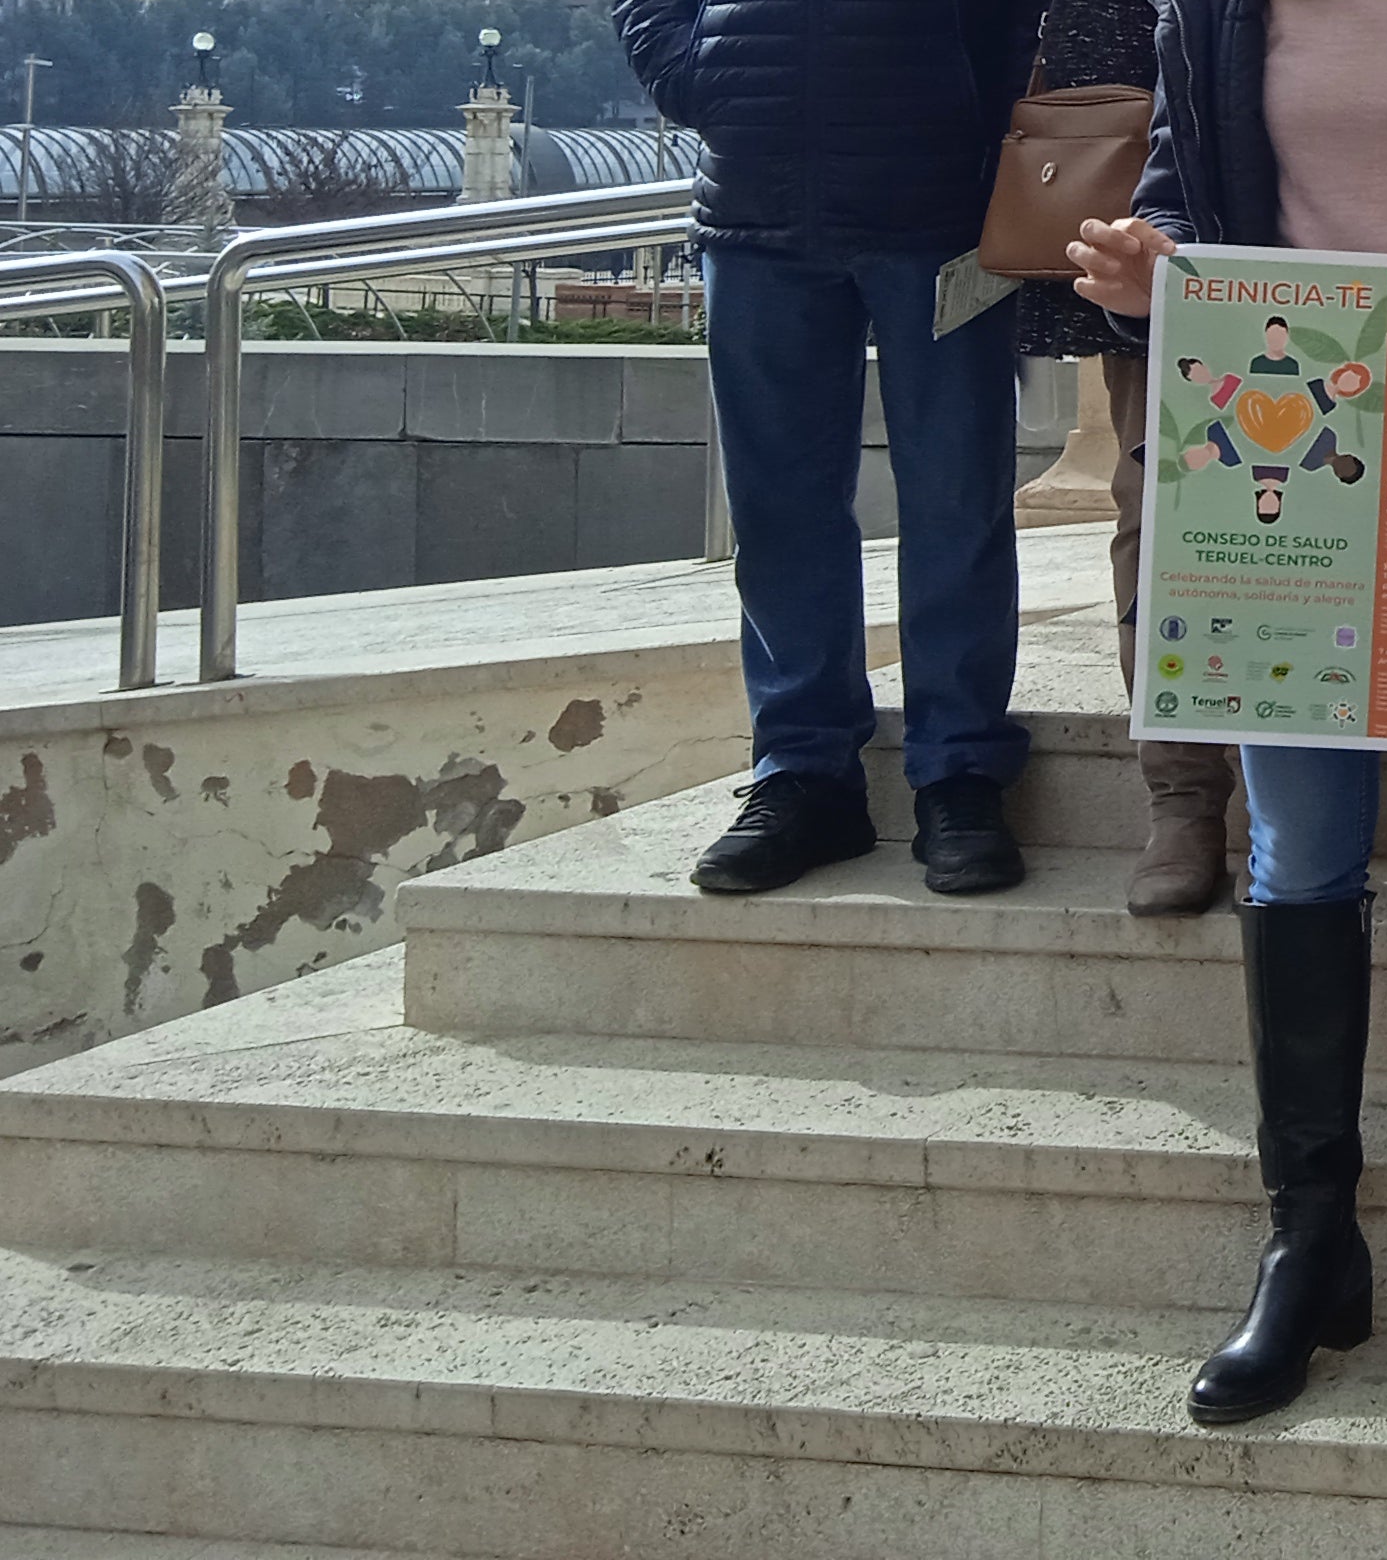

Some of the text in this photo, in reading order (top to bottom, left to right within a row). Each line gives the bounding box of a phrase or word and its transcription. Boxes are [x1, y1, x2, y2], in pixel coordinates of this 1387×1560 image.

[1183, 276, 1373, 310] REINICIA-TE
[1182, 530, 1347, 550] CONSEJO DE SALUD
[1195, 548, 1333, 568] TERUEL-CENTRO
[1160, 569, 1365, 590] Celebrando la salud de manera
[1244, 589, 1299, 602] solidaria
[1303, 595, 1309, 605] y
[1313, 592, 1354, 607] alegre
[1191, 695, 1226, 707] Teruel
